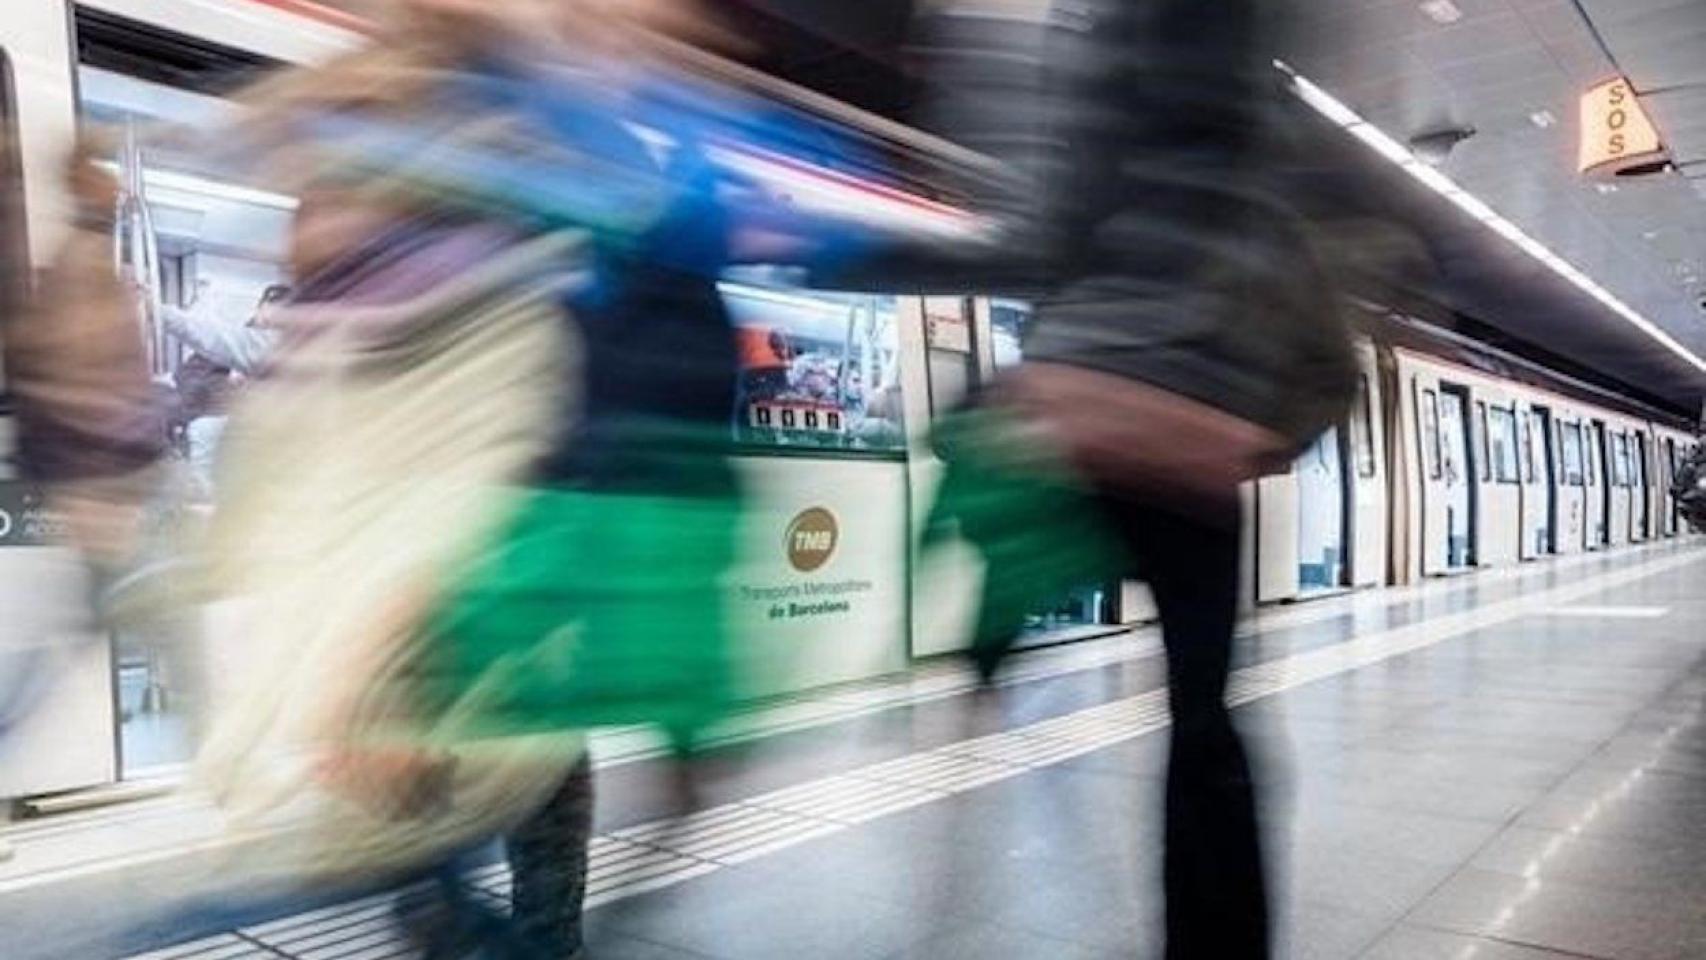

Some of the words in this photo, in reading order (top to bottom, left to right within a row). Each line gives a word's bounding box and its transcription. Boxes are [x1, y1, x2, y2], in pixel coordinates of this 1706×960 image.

[1607, 84, 1626, 154] SOS
[795, 530, 832, 552] TMB
[768, 603, 785, 619] de
[789, 600, 850, 618] Barcelona
